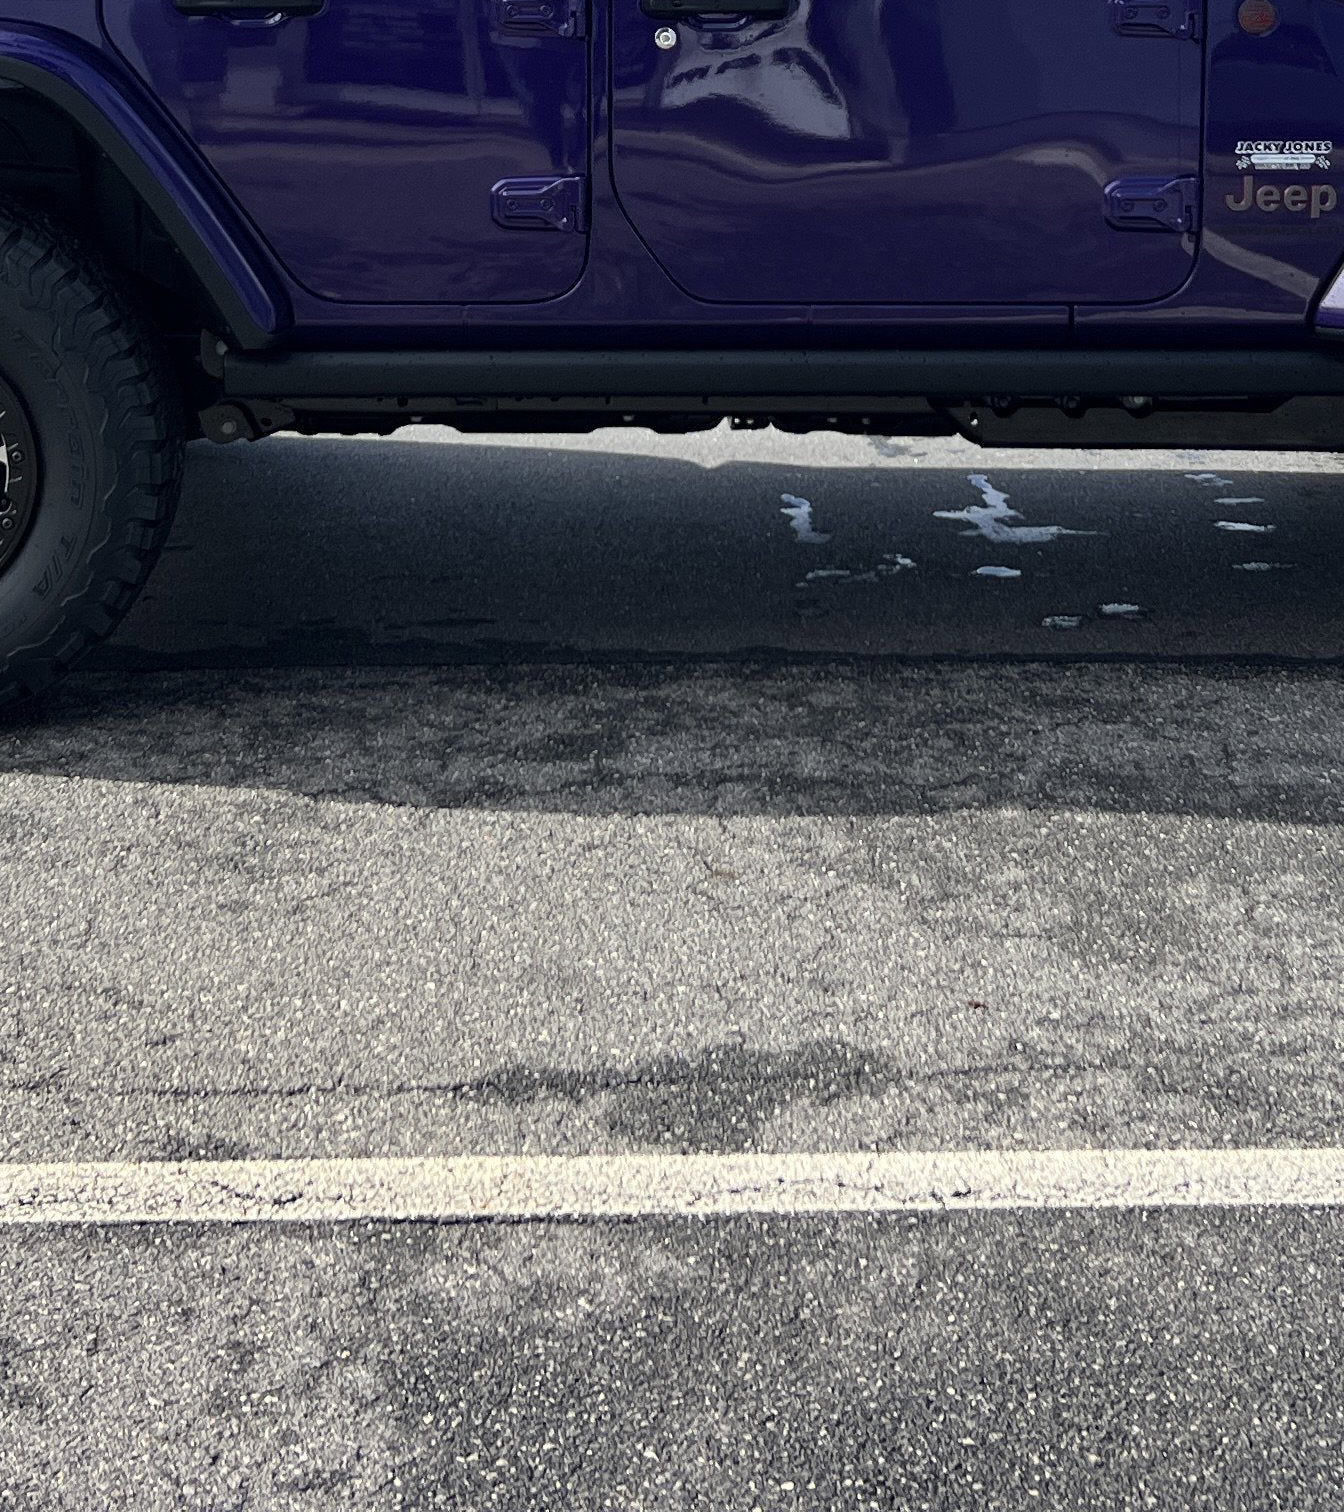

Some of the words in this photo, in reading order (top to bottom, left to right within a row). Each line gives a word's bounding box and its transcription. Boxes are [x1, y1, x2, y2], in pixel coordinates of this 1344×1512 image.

[1236, 141, 1283, 154] JACKY
[1283, 141, 1333, 154] JONES
[1225, 175, 1337, 219] Jeep
